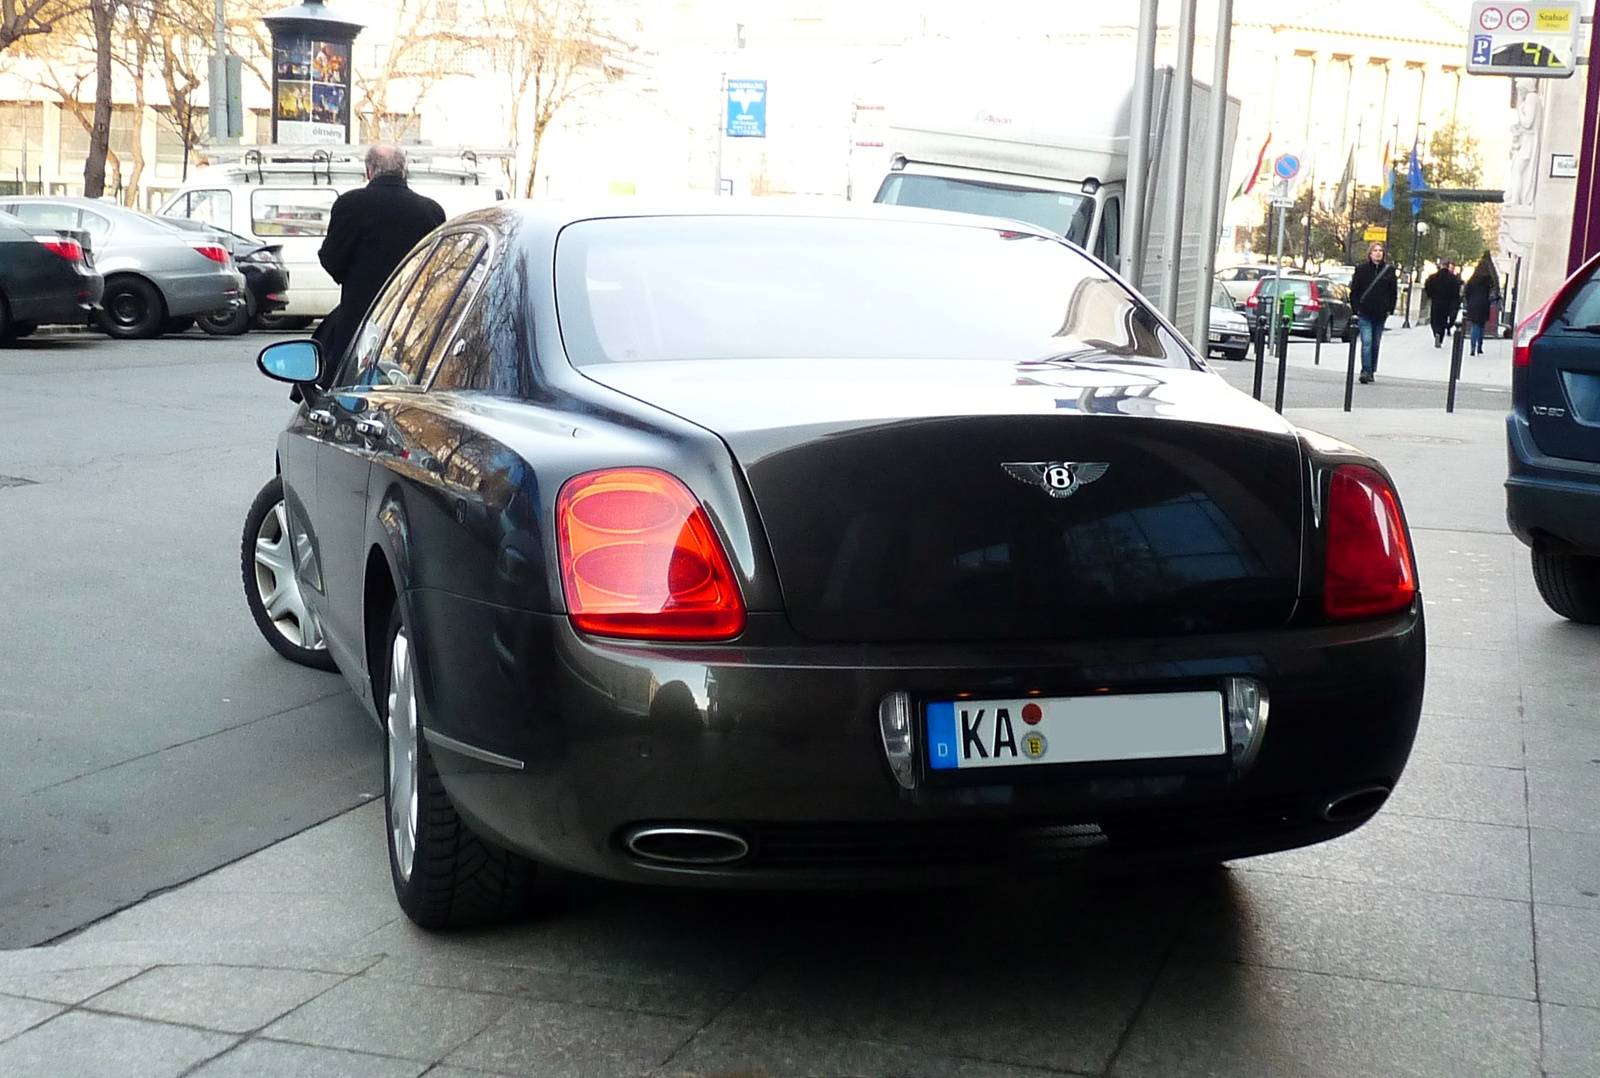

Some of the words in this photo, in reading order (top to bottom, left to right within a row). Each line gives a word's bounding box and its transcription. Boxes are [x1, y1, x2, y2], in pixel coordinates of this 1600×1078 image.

[1511, 15, 1526, 23] LPG
[1538, 12, 1568, 22] Szabad
[1477, 40, 1488, 54] P
[1049, 467, 1070, 488] B
[937, 742, 949, 757] D
[958, 708, 1018, 759] KA
